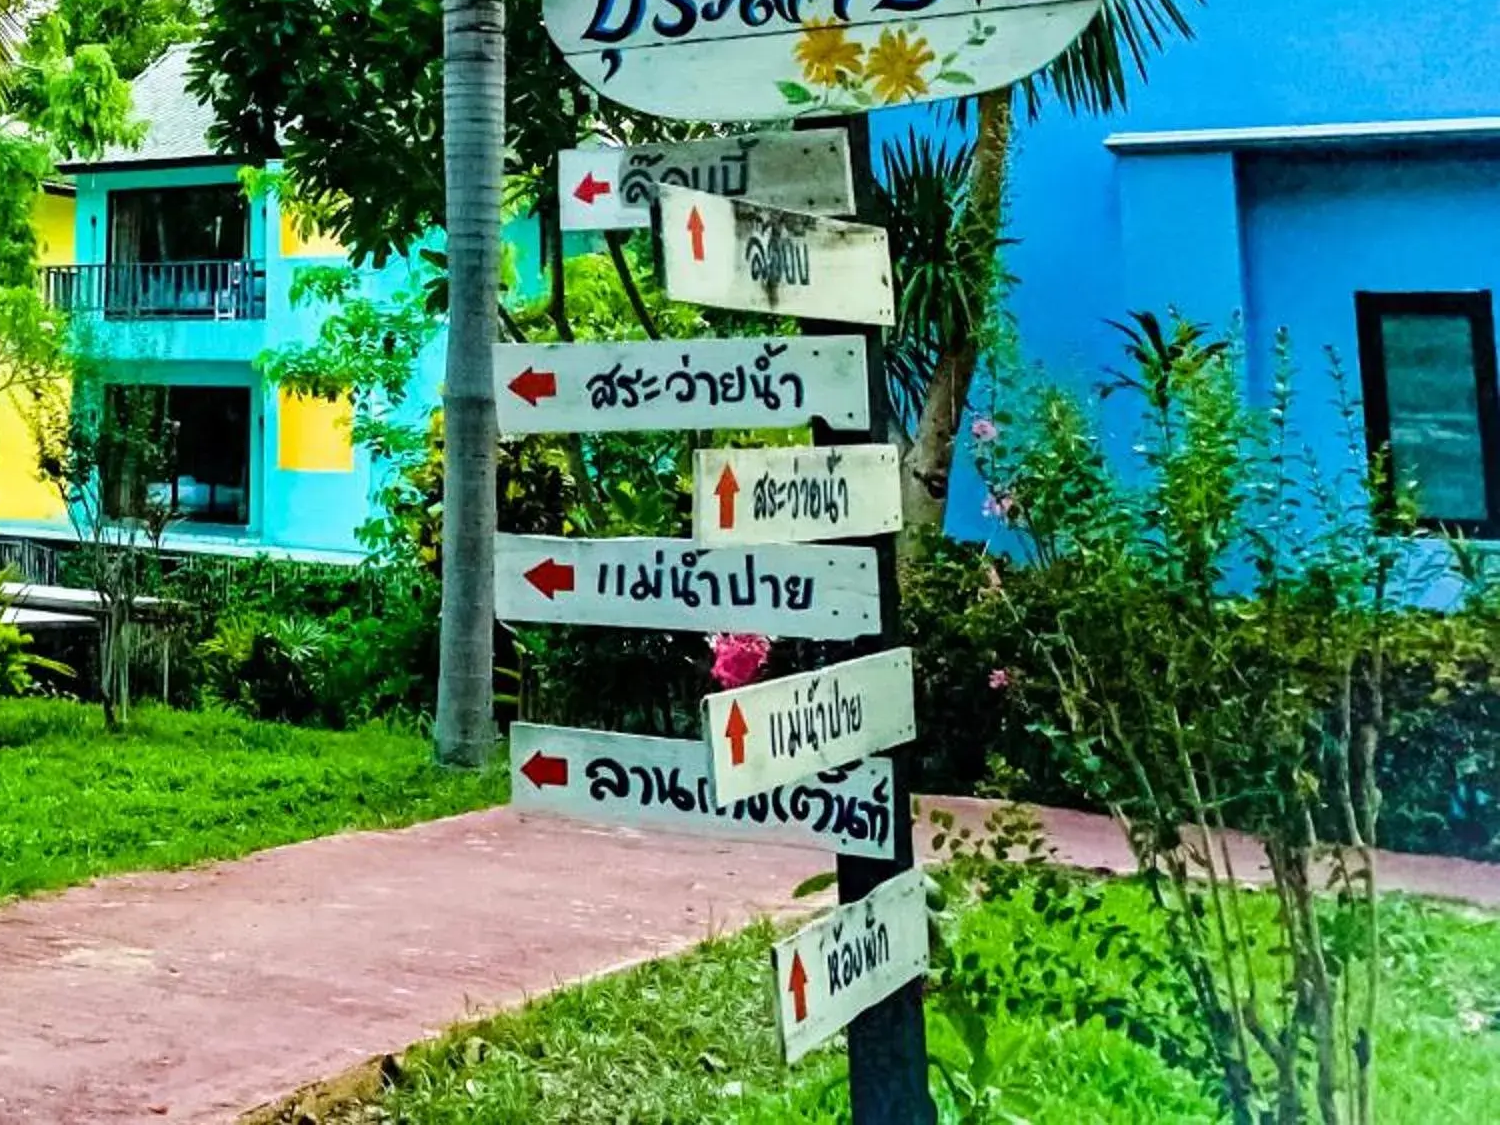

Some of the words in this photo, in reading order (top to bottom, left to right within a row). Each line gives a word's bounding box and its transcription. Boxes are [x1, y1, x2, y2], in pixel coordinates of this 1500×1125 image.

[585, 344, 805, 410] สระว่ายน้ำ
[753, 449, 849, 524] สระว่ายน้ำ
[769, 677, 863, 759] แม่น้ำปาย
[827, 913, 890, 996] ห้องพัก
